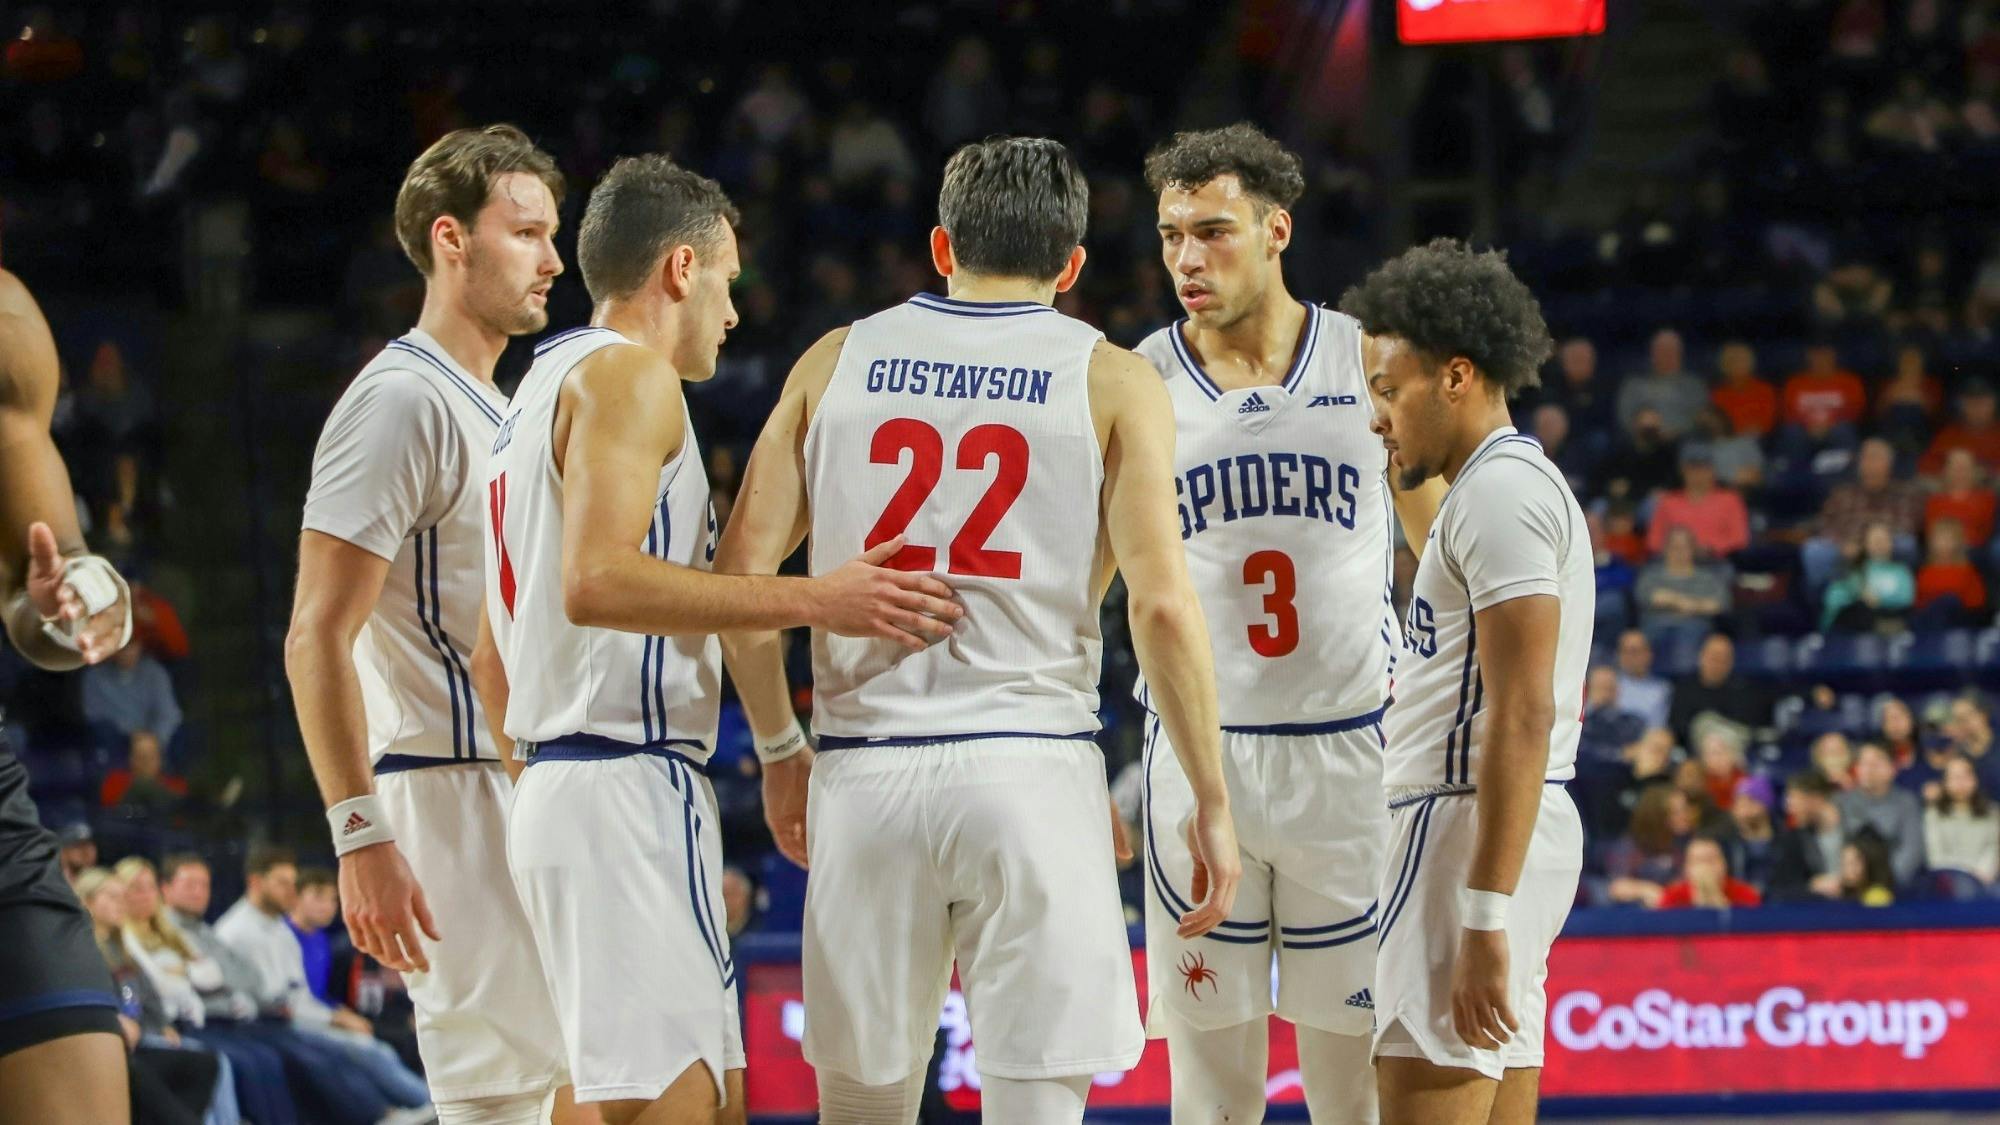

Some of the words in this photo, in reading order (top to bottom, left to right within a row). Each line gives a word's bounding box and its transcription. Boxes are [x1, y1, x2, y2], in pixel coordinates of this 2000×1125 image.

[866, 358, 1053, 405] GUSTAVSON
[1237, 403, 1271, 414] adidas
[864, 417, 1030, 580] 22
[1242, 549, 1300, 658] 3
